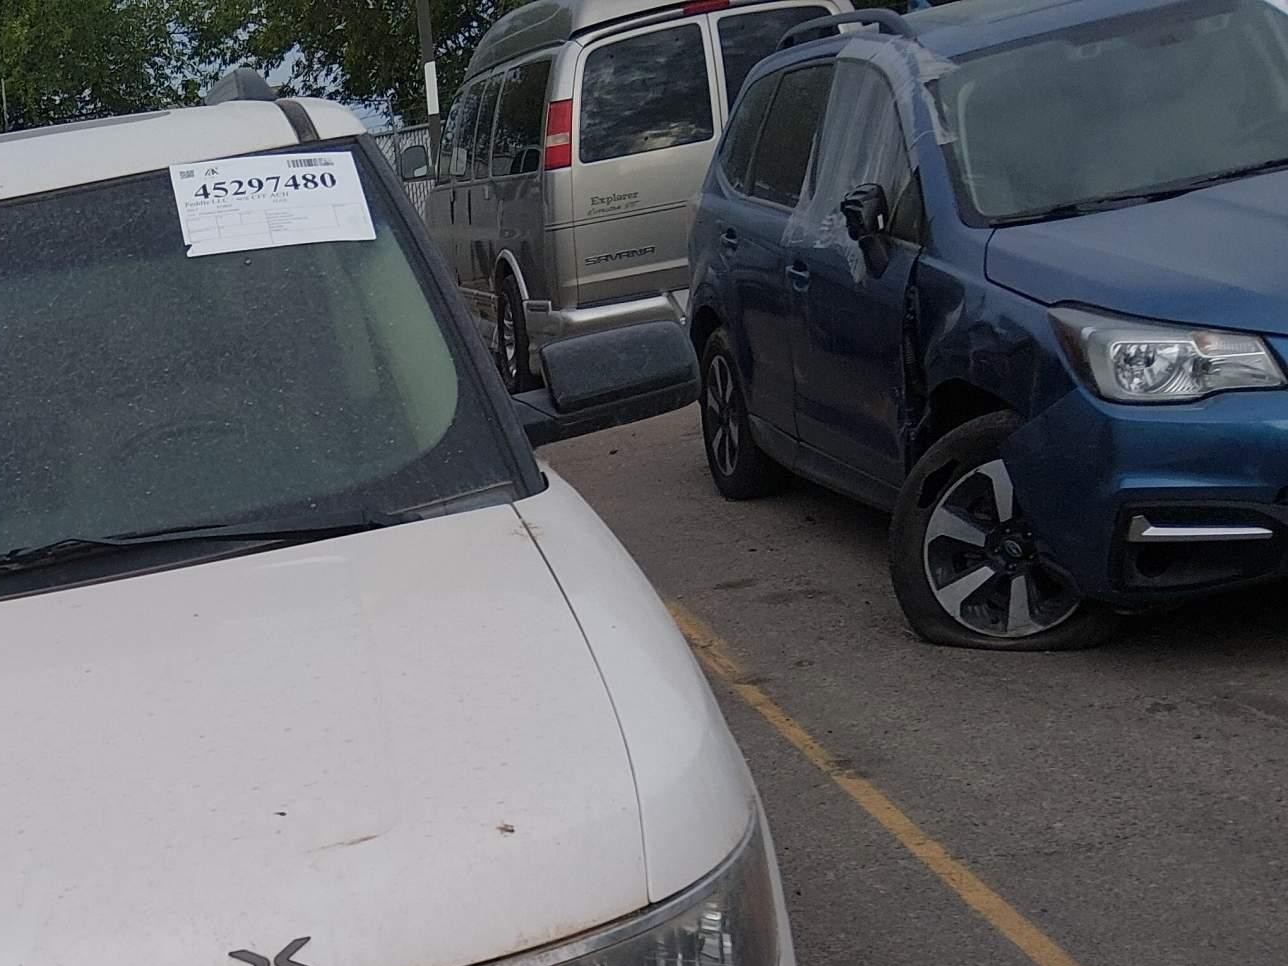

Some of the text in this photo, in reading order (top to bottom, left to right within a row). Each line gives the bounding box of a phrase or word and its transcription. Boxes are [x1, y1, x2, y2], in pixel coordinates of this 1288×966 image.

[194, 172, 337, 199] 45297480
[591, 191, 640, 206] Explorer
[584, 246, 655, 266] SAVANA
